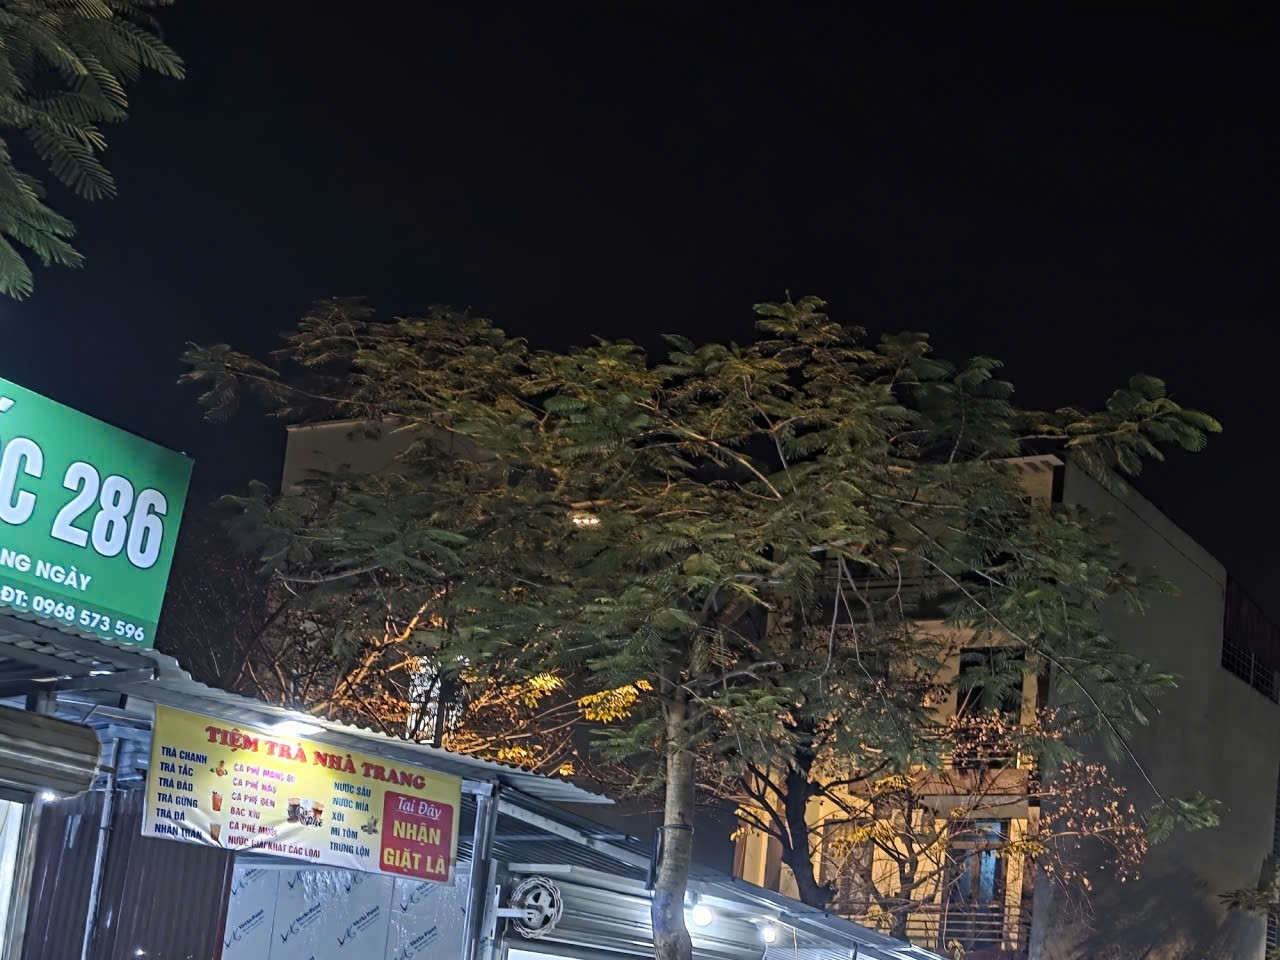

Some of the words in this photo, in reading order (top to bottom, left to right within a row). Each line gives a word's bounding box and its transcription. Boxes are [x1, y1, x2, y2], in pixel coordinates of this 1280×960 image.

[51, 461, 168, 569] 286
[35, 559, 92, 591] NGÀY
[32, 596, 76, 621] 0968
[79, 610, 111, 631] 573
[114, 621, 145, 641] 596
[179, 750, 207, 765] CHANH
[205, 725, 260, 752] TIỆM
[264, 740, 307, 763] TRÀ
[313, 751, 356, 775] NHÀ
[361, 761, 426, 790] TRANG
[397, 796, 415, 814] Tại
[418, 801, 442, 820] Đây
[393, 820, 441, 846] NHẬN
[383, 848, 422, 872] GIẶT
[426, 854, 446, 875] LÀ
